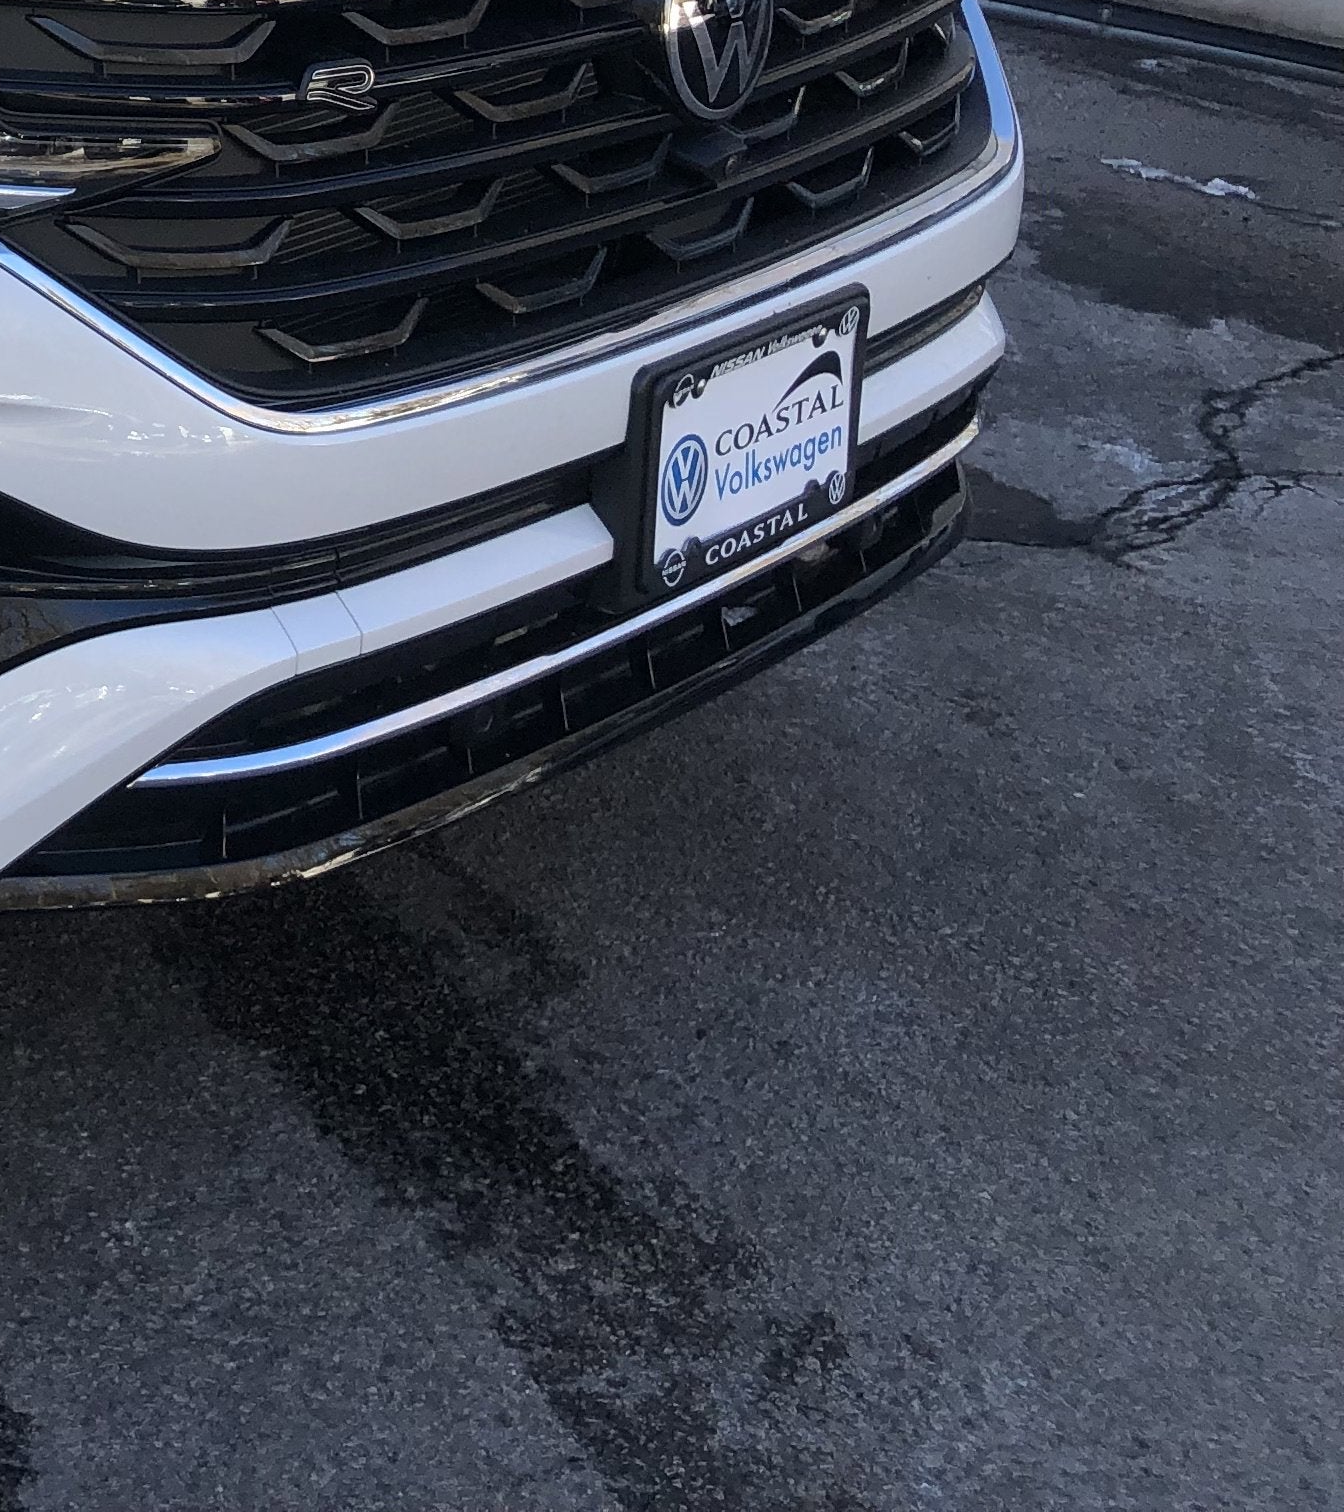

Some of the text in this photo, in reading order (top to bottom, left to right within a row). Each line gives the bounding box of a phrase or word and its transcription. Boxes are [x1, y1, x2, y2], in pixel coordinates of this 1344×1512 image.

[710, 346, 767, 379] NISSAN
[715, 384, 844, 456] COASTAL
[714, 425, 842, 501] Volkswagen
[705, 502, 808, 565] COASTAL
